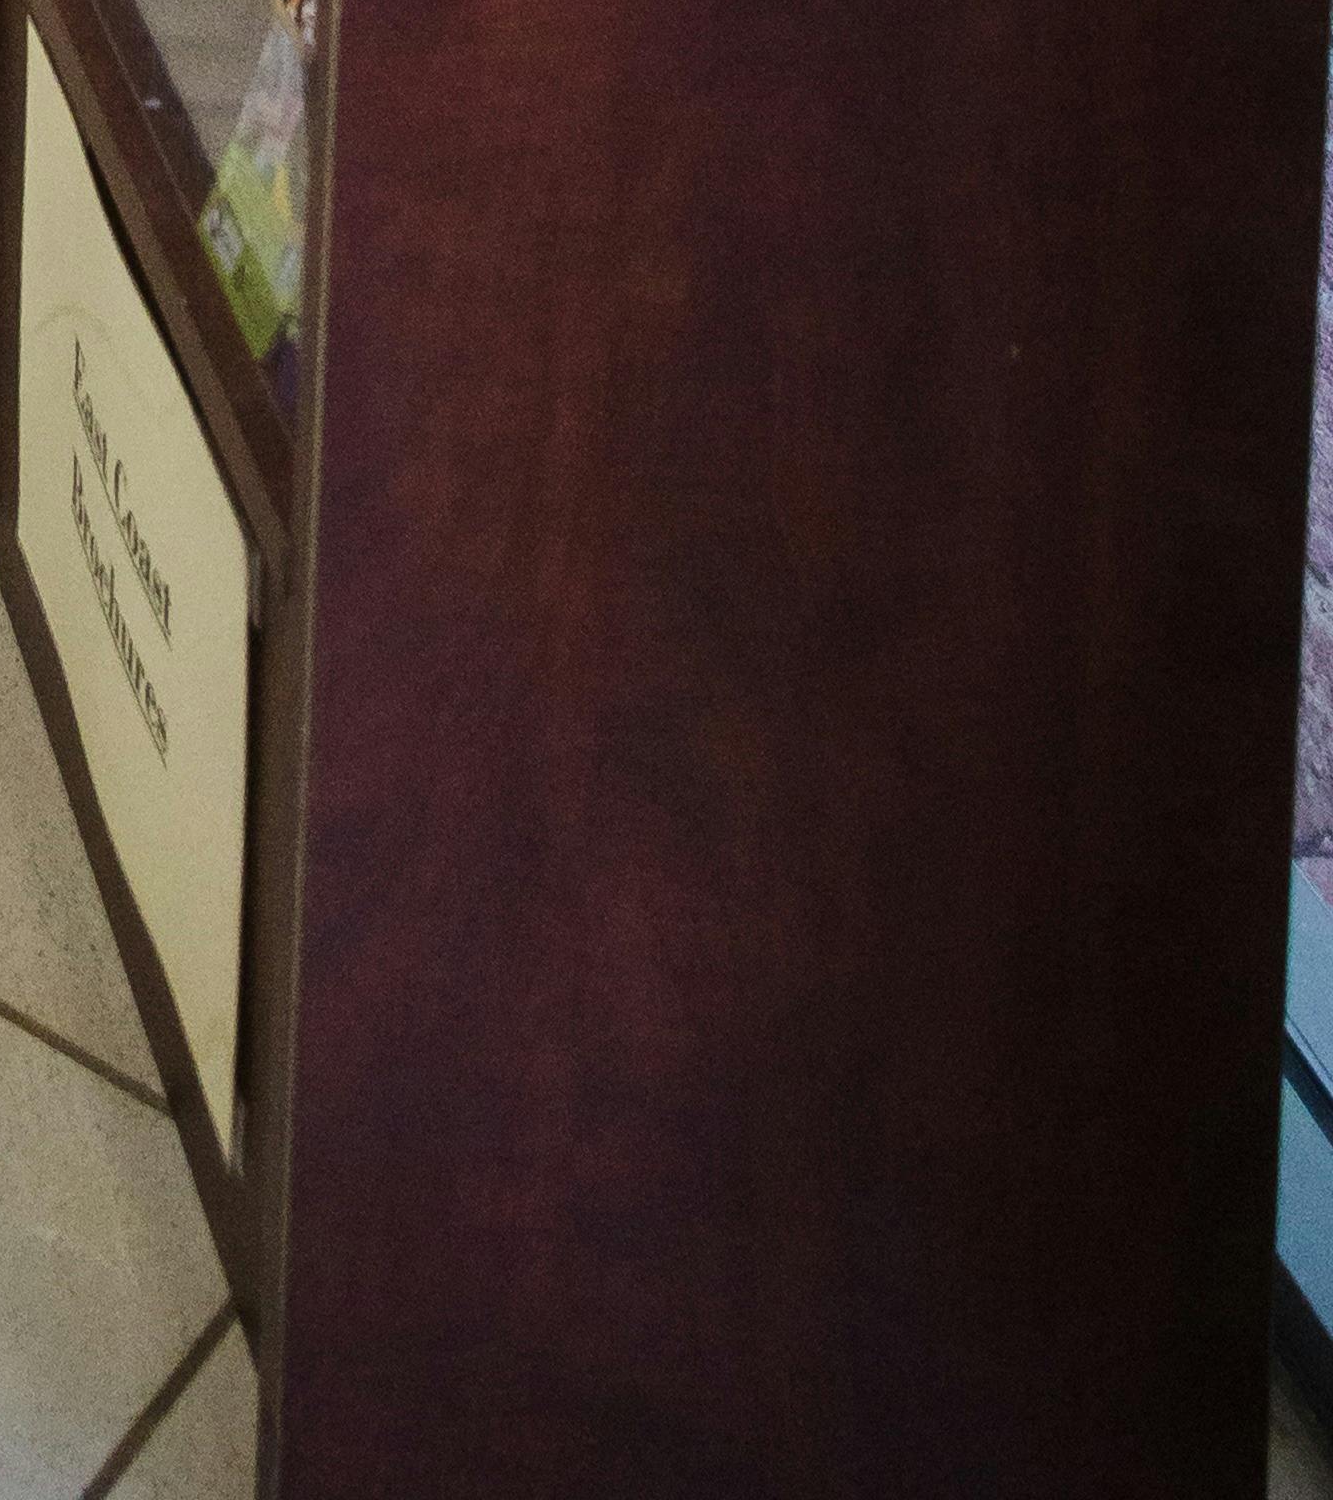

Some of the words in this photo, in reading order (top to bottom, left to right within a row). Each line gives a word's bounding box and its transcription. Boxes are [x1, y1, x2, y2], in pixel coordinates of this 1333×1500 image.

[71, 446, 169, 758] Brochures
[73, 335, 108, 484] East
[114, 458, 173, 640] Coast
